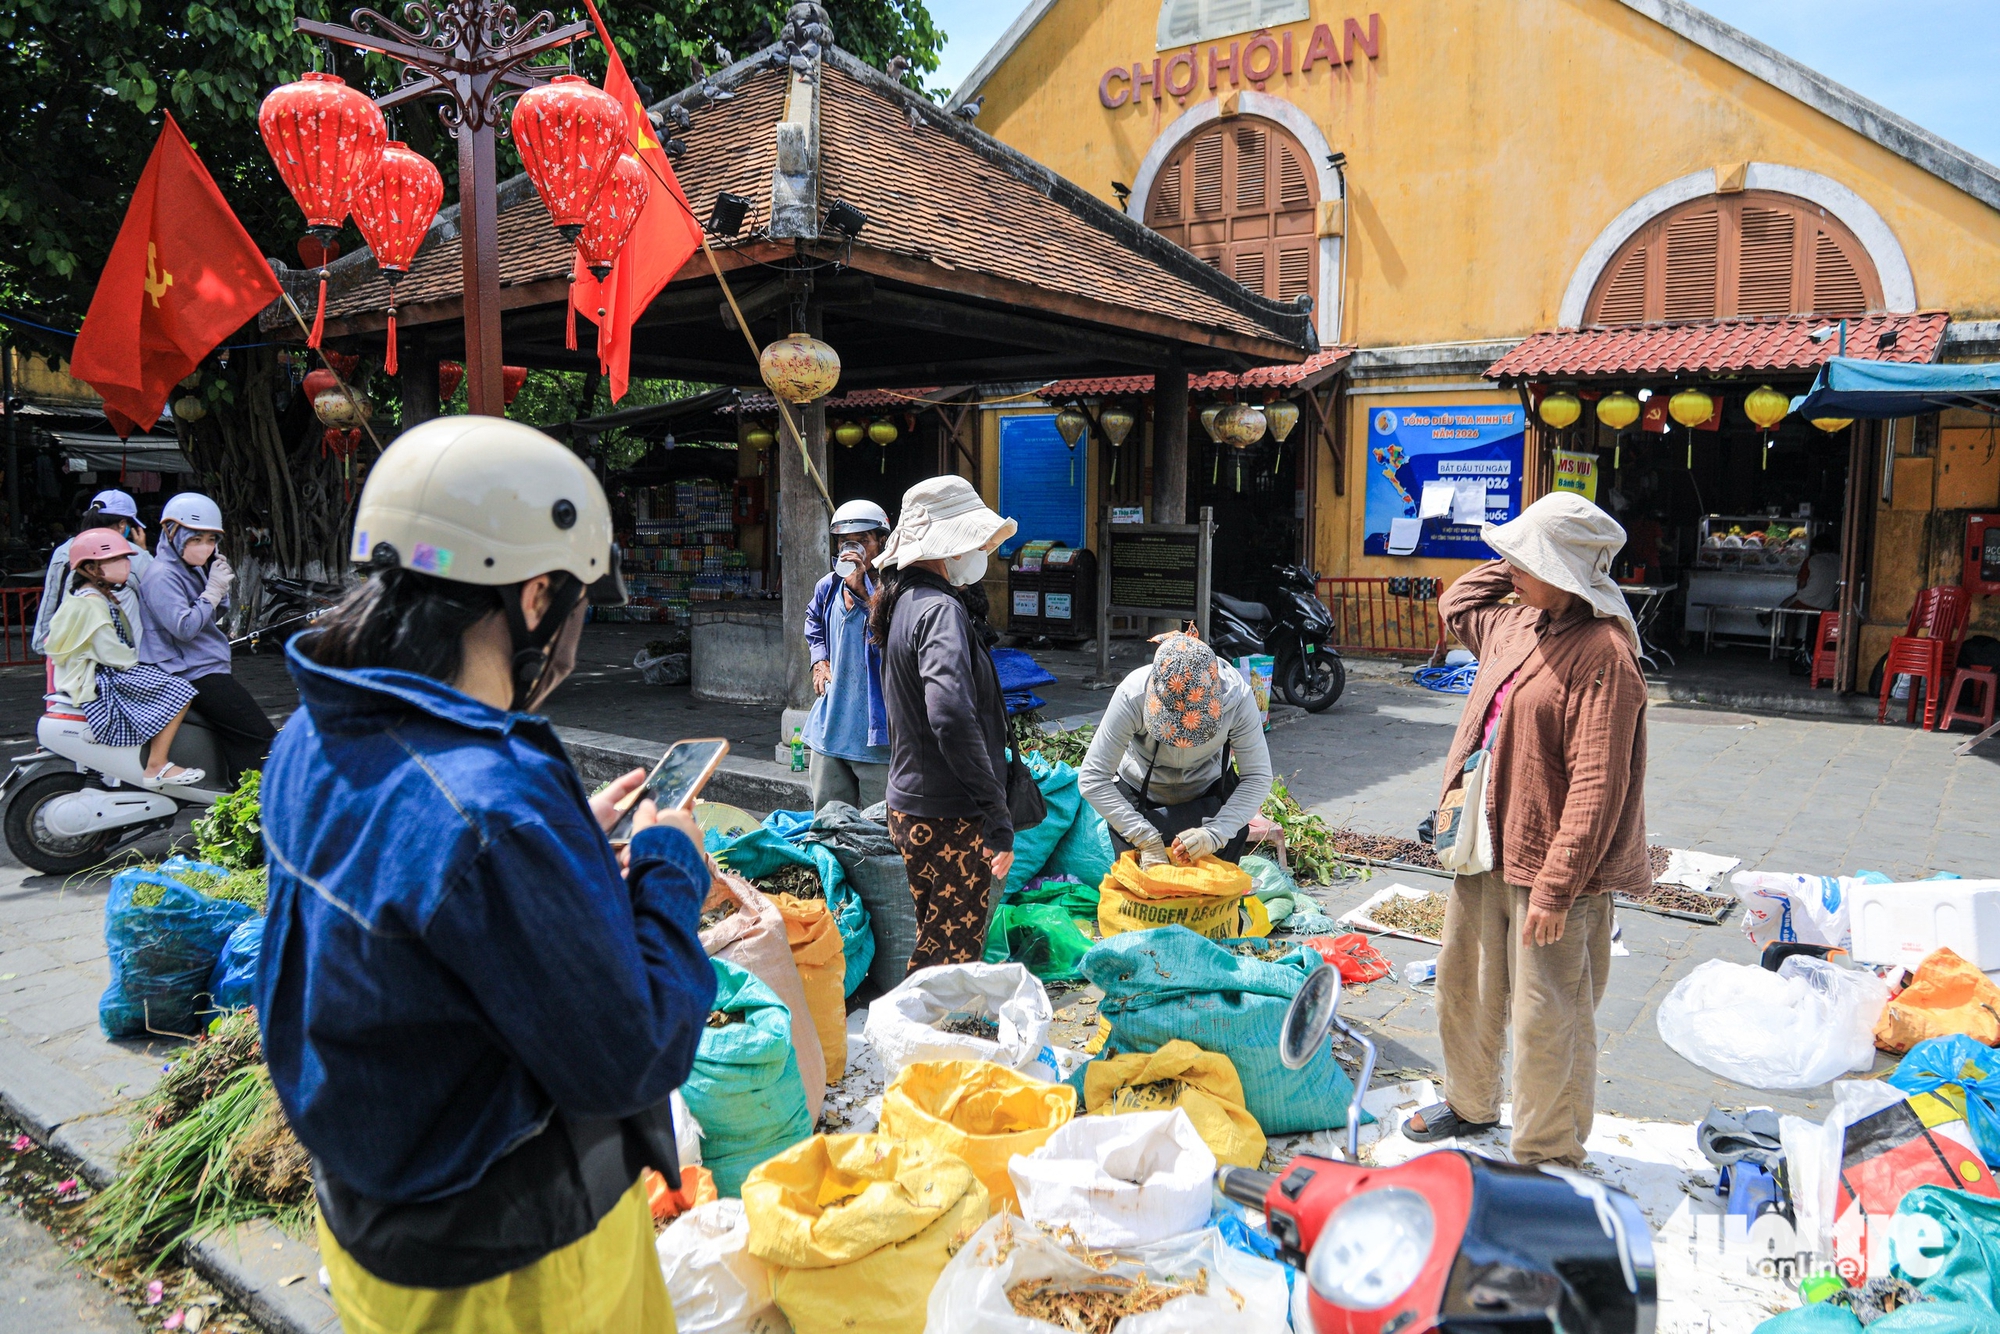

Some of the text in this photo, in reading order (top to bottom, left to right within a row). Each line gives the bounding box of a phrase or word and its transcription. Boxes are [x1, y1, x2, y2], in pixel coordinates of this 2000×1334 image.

[1099, 13, 1380, 109] CHỢ HỘI AN
[1456, 415, 1474, 426] TRA
[1476, 414, 1500, 425] KINH
[1501, 411, 1515, 425] TẾ
[1432, 427, 1479, 439] NĂM 2026
[1558, 458, 1591, 475] MS VUI
[1118, 900, 1189, 925] NITROGEN
